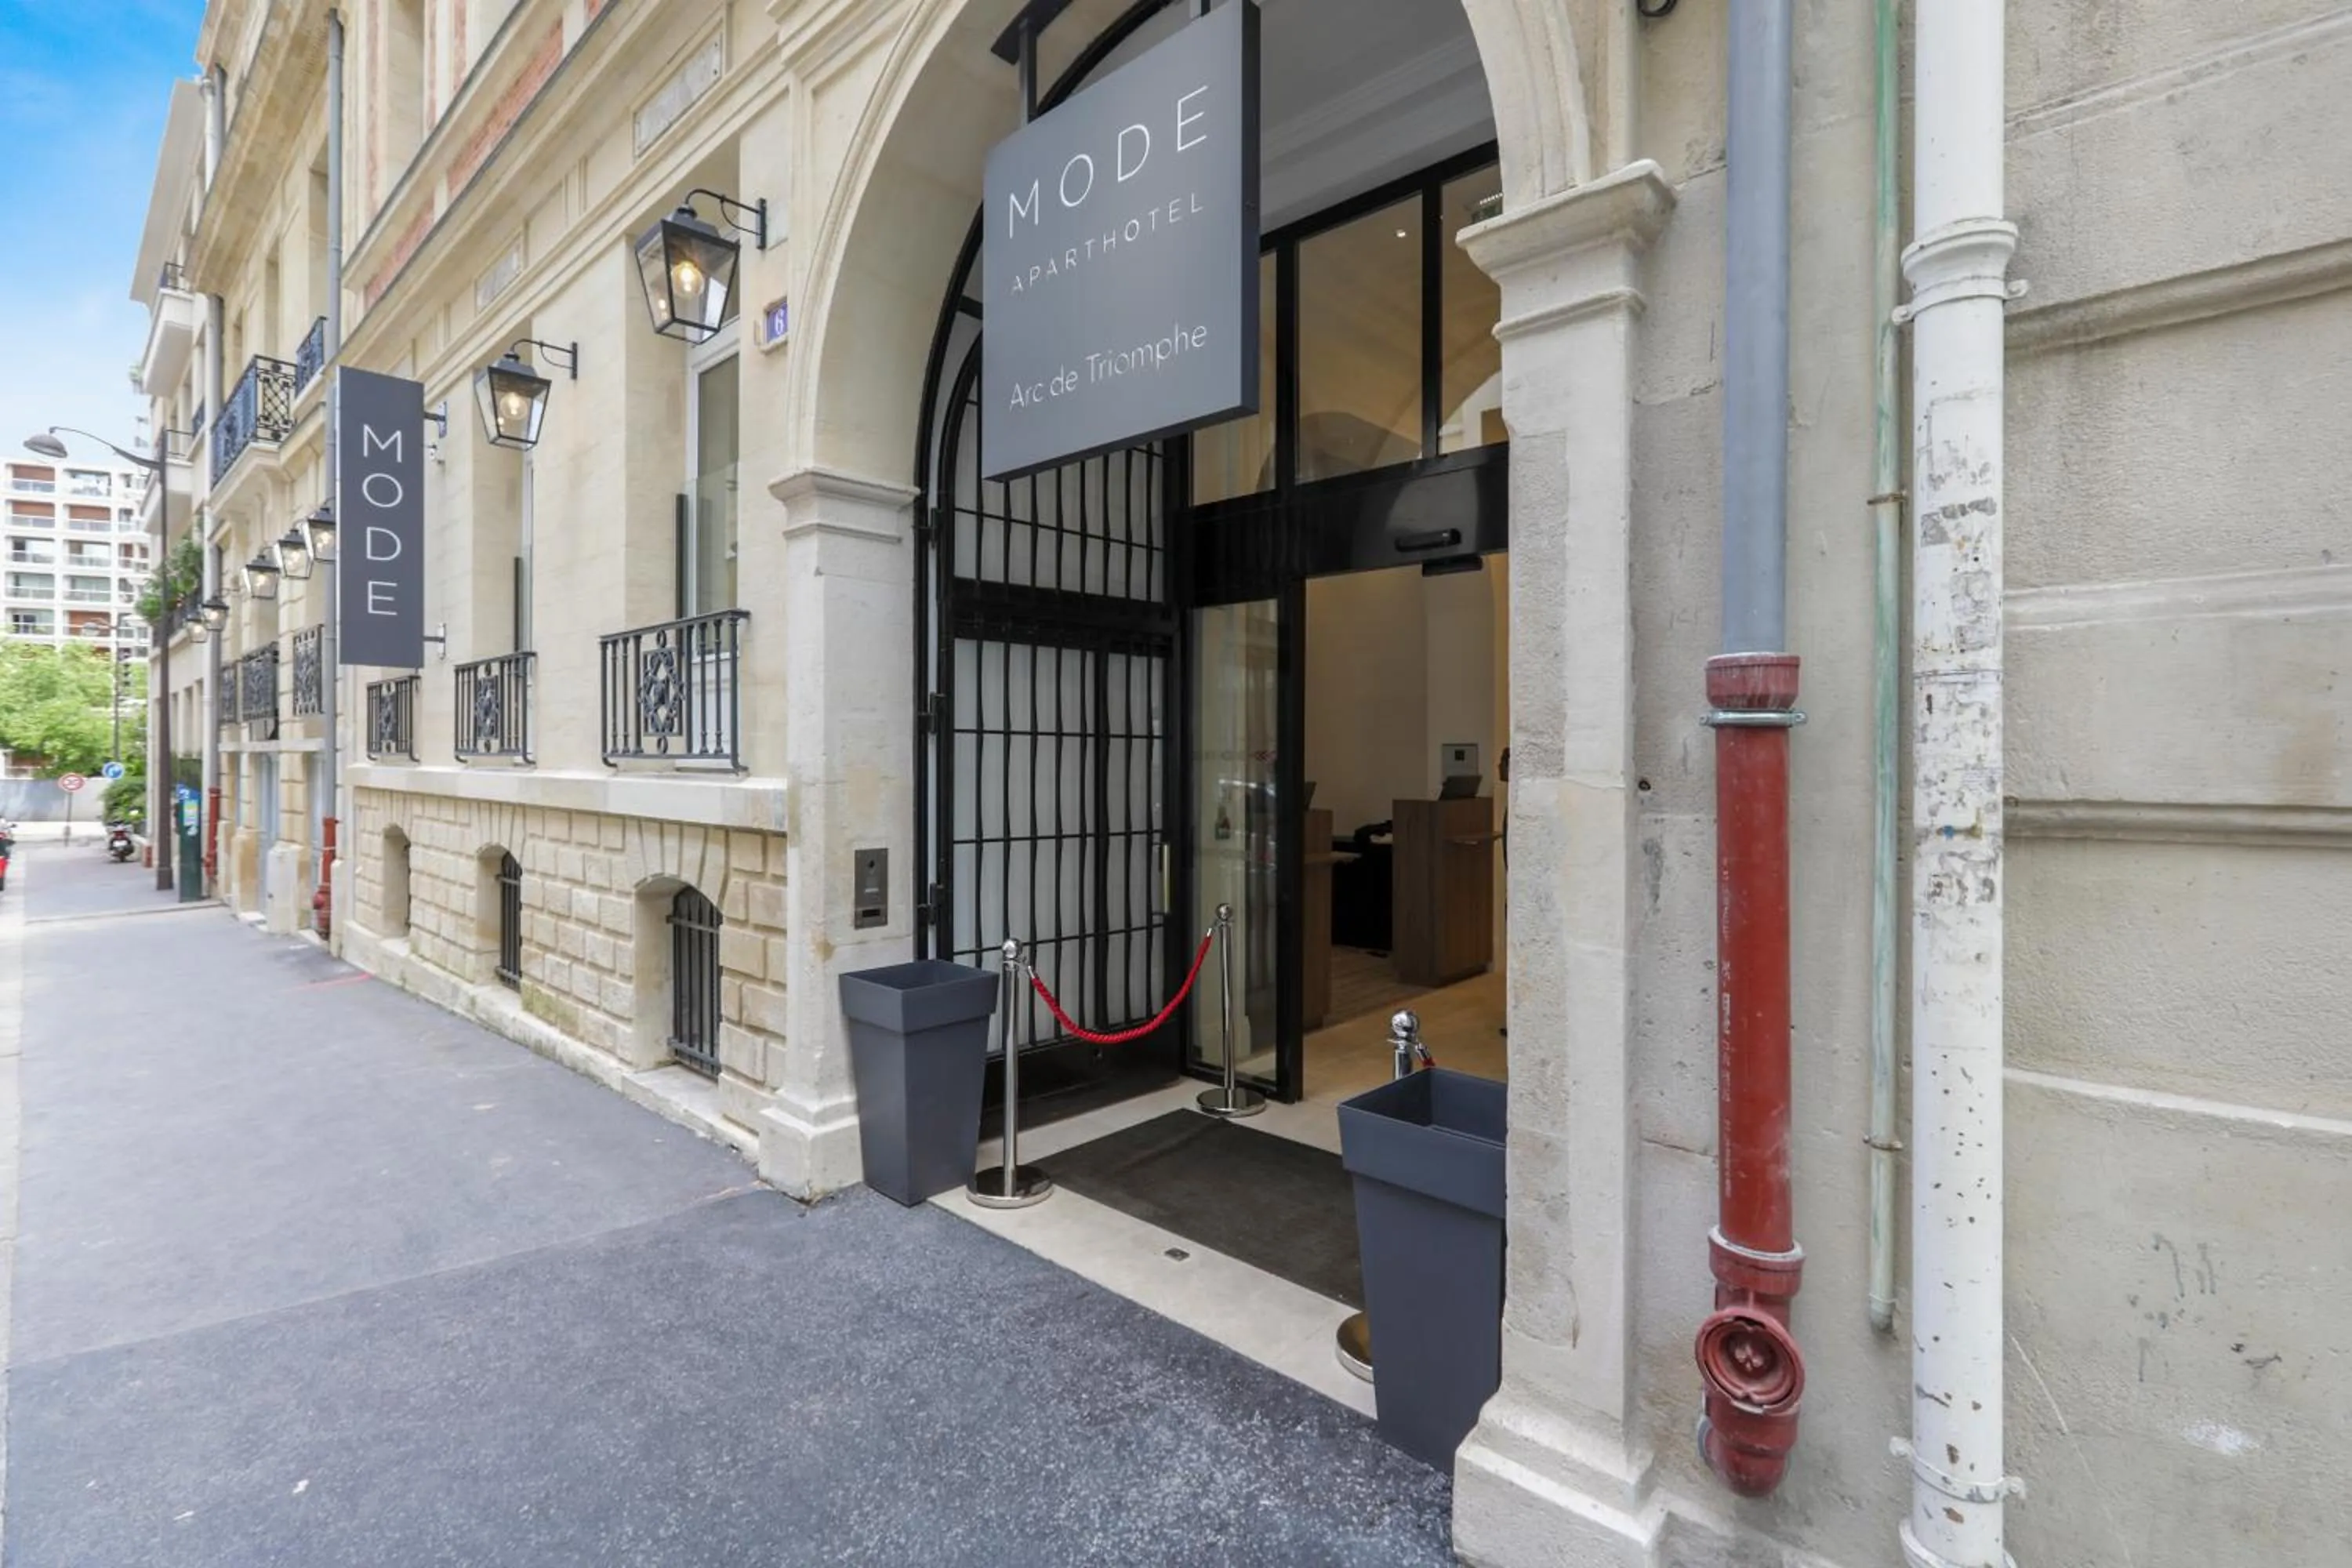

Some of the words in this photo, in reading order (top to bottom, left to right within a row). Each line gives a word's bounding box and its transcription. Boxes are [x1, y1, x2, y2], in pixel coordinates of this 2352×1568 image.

[1008, 83, 1210, 240] MODE
[1010, 192, 1205, 295] APARTHOTEL
[775, 308, 785, 335] 6
[1009, 382, 1044, 412] Arc
[1050, 363, 1079, 397] de
[1085, 321, 1208, 384] Triomphe
[361, 423, 404, 616] MODE
